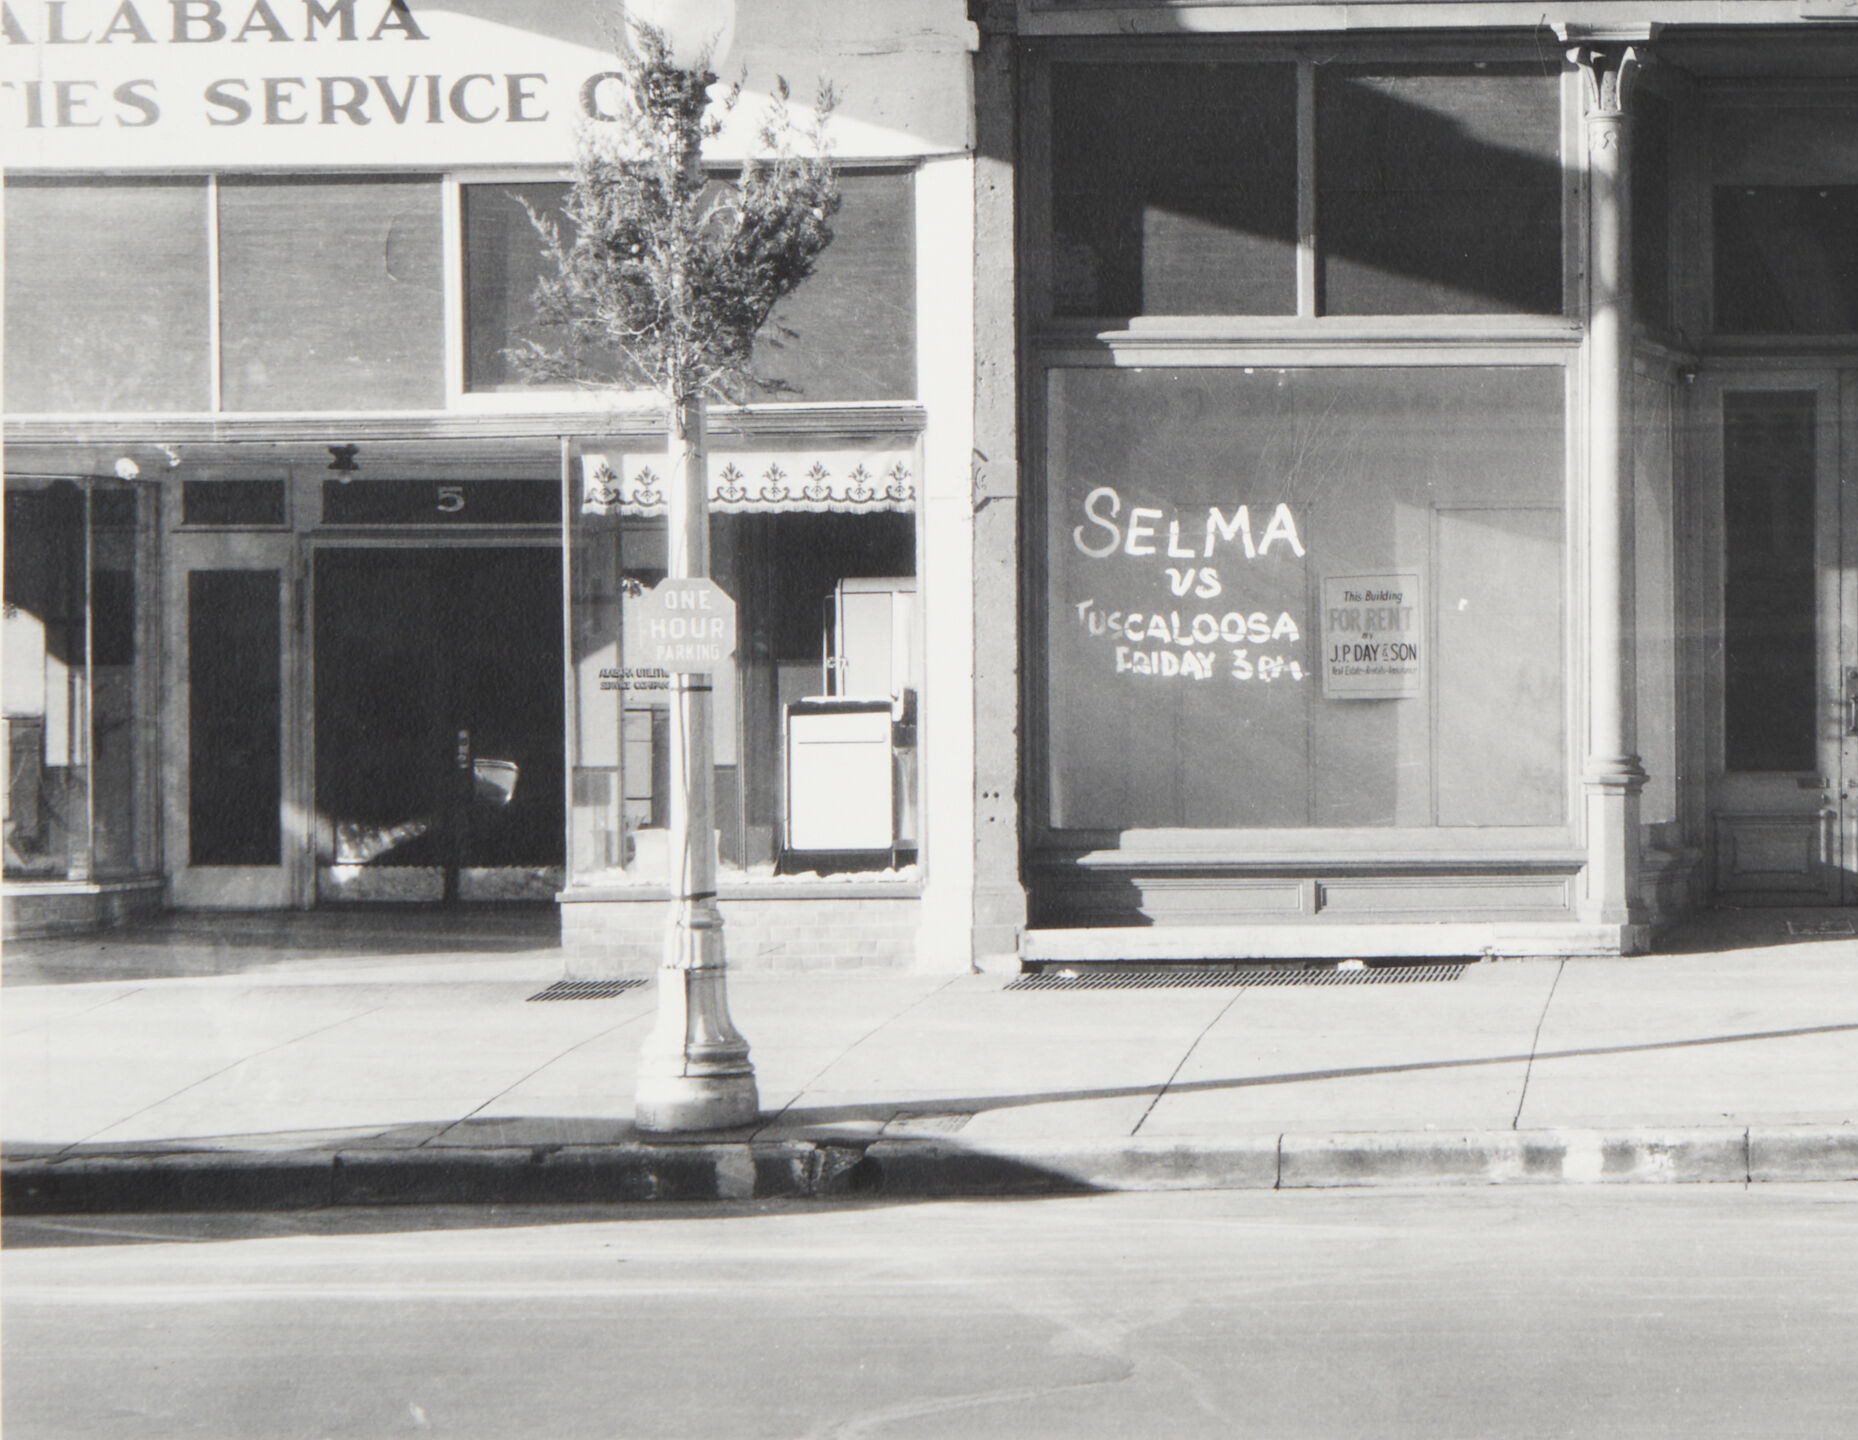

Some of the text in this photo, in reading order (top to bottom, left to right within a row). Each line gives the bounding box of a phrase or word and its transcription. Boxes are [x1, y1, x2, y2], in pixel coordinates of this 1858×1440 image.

[204, 71, 549, 126] SERVICE
[437, 486, 465, 512] 5
[665, 589, 712, 610] ONE
[1344, 589, 1403, 604] This Building
[650, 617, 725, 639] HOUR
[1328, 606, 1413, 632] FOR RENT
[656, 643, 721, 661] PARKING
[1354, 644, 1379, 662] DAY
[1390, 643, 1417, 661] SON
[1231, 648, 1253, 680] 3
